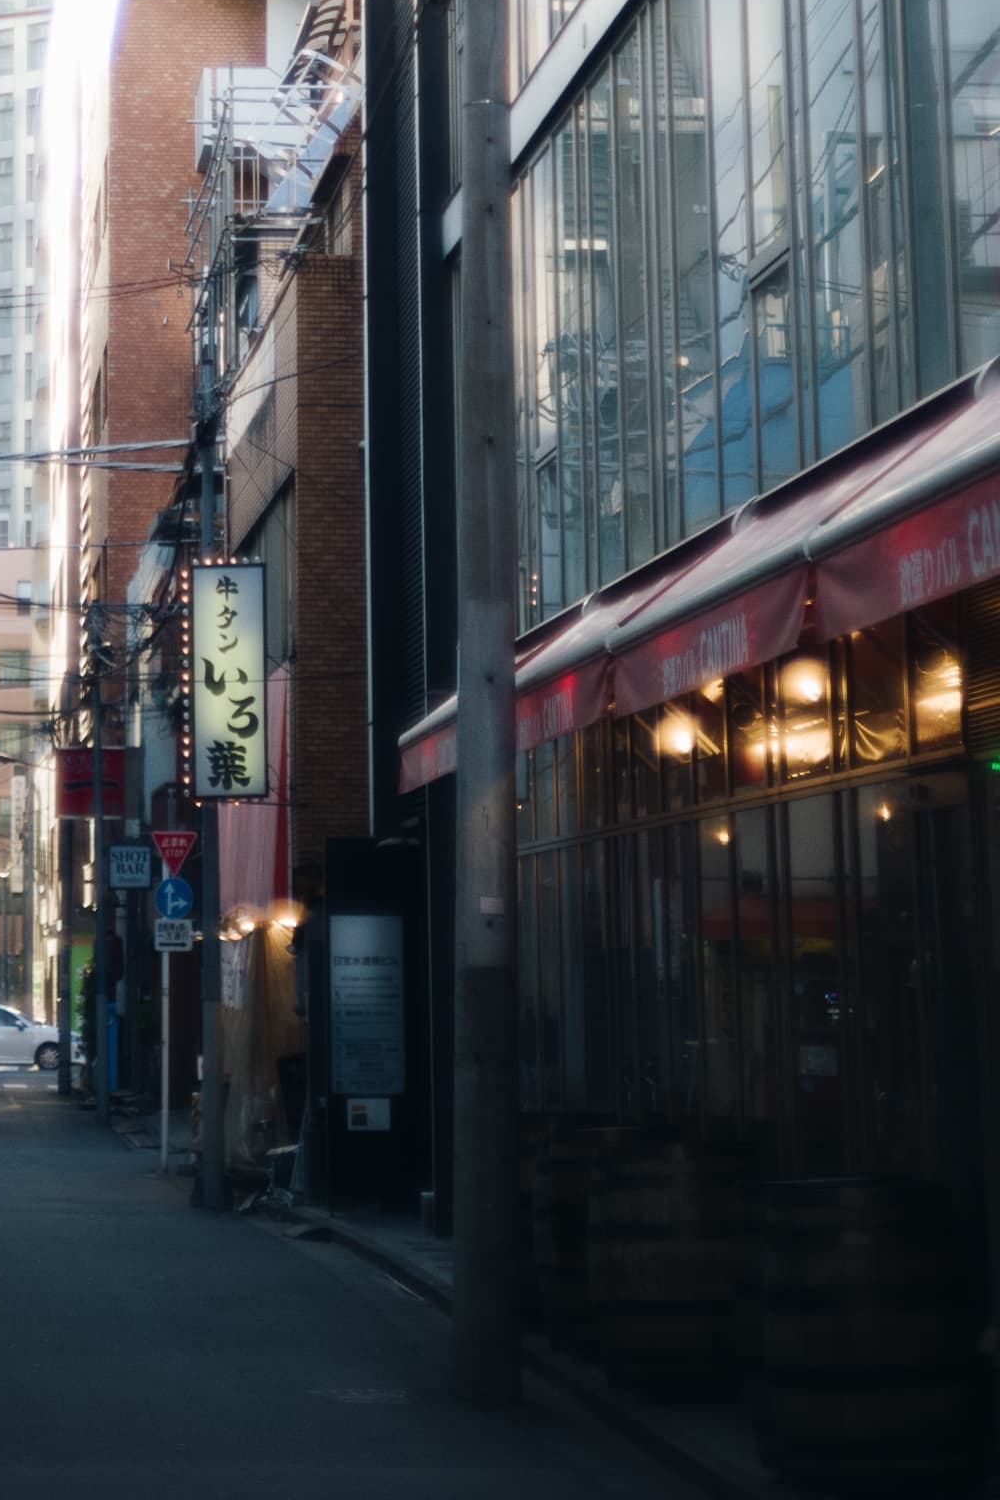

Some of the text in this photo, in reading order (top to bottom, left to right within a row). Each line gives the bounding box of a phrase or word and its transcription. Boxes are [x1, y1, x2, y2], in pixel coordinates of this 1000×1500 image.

[216, 576, 239, 654] 牛タン
[201, 657, 260, 790] いろ葉
[162, 836, 188, 848] 止まれ
[111, 851, 148, 862] SHOT
[165, 849, 184, 858] STOP
[116, 863, 145, 875] BAR
